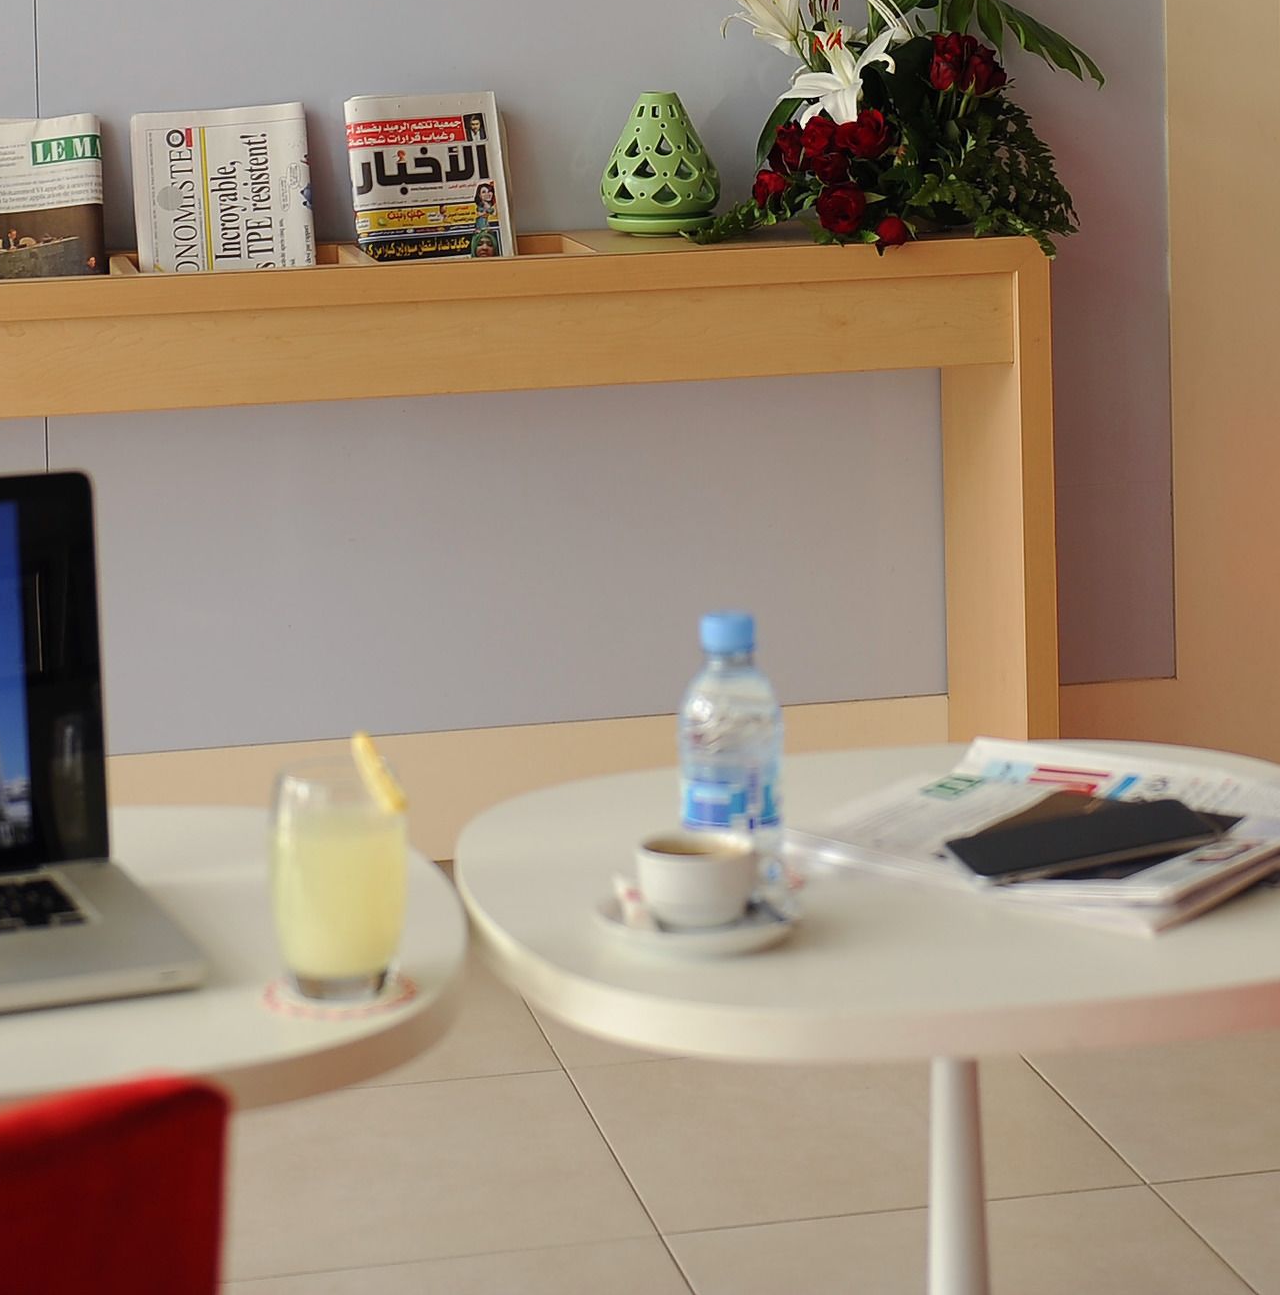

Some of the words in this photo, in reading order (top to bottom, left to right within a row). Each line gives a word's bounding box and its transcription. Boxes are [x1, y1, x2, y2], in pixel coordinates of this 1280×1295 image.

[35, 140, 65, 163] LE
[240, 133, 272, 212] résistent!
[356, 145, 490, 195] الأخبار
[210, 161, 242, 260] Incroyable,
[245, 216, 274, 258] TPE
